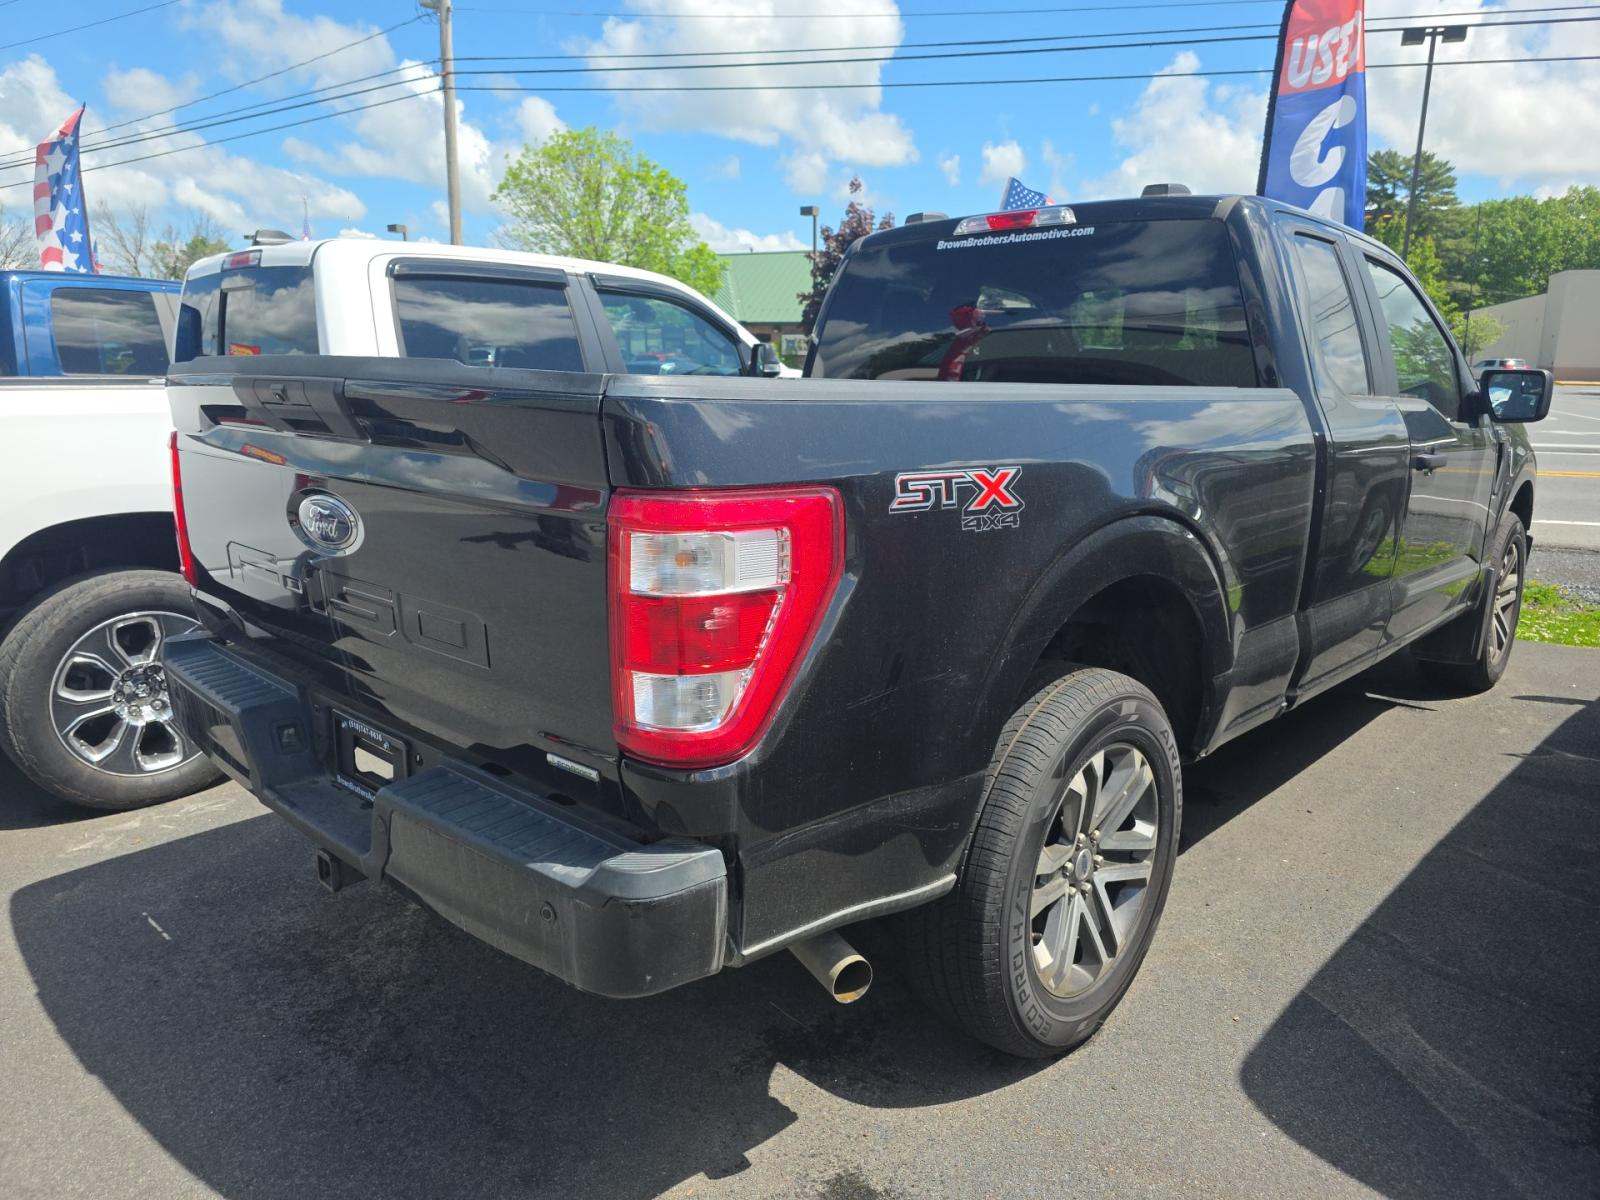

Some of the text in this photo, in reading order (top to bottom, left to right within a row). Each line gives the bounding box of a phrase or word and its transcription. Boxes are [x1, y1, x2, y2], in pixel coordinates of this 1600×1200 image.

[937, 227, 1095, 250] BrownBrothersAutomotive.com
[889, 466, 1025, 514] STX
[307, 506, 338, 538] Ford
[226, 540, 491, 671] F-150
[1013, 951, 1031, 1006] PRO
[1025, 1004, 1053, 1039] ECO
